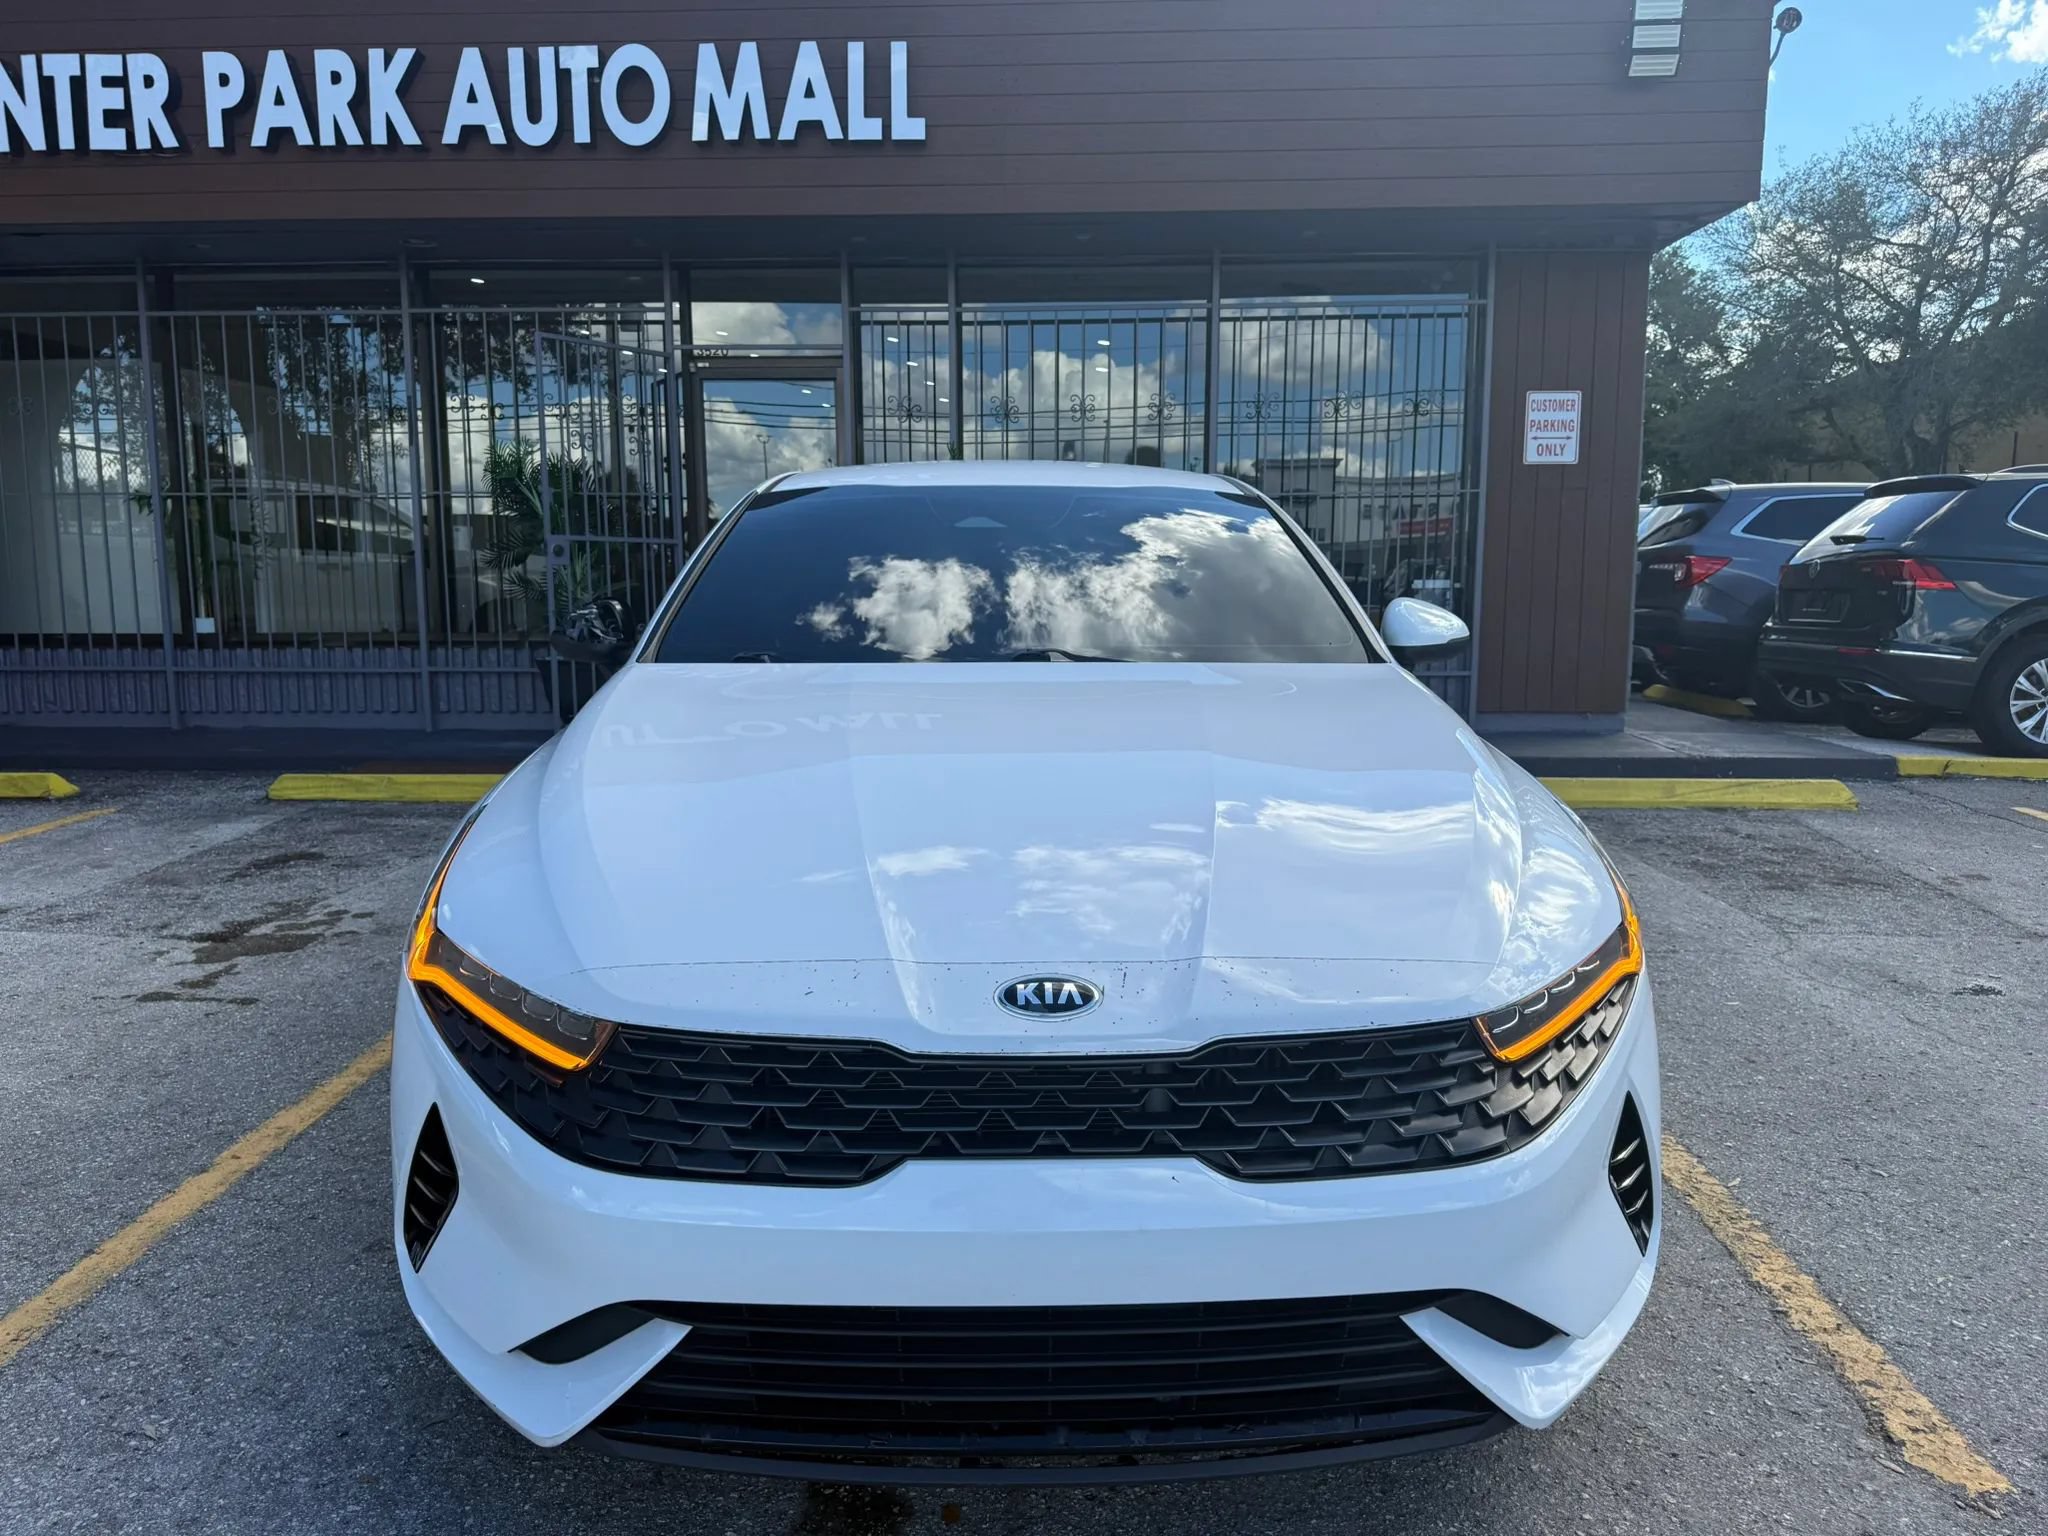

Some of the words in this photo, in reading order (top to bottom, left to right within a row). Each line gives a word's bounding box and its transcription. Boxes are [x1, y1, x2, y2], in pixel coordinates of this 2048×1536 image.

[0, 53, 179, 152] NTER
[202, 48, 422, 148] PARK
[442, 44, 671, 147] AUTO
[692, 41, 926, 141] MALL
[1530, 399, 1576, 412] CUSTOMER
[1529, 419, 1575, 432] PARKING
[1536, 443, 1567, 457] ONLY
[1015, 981, 1084, 1006] KIA
